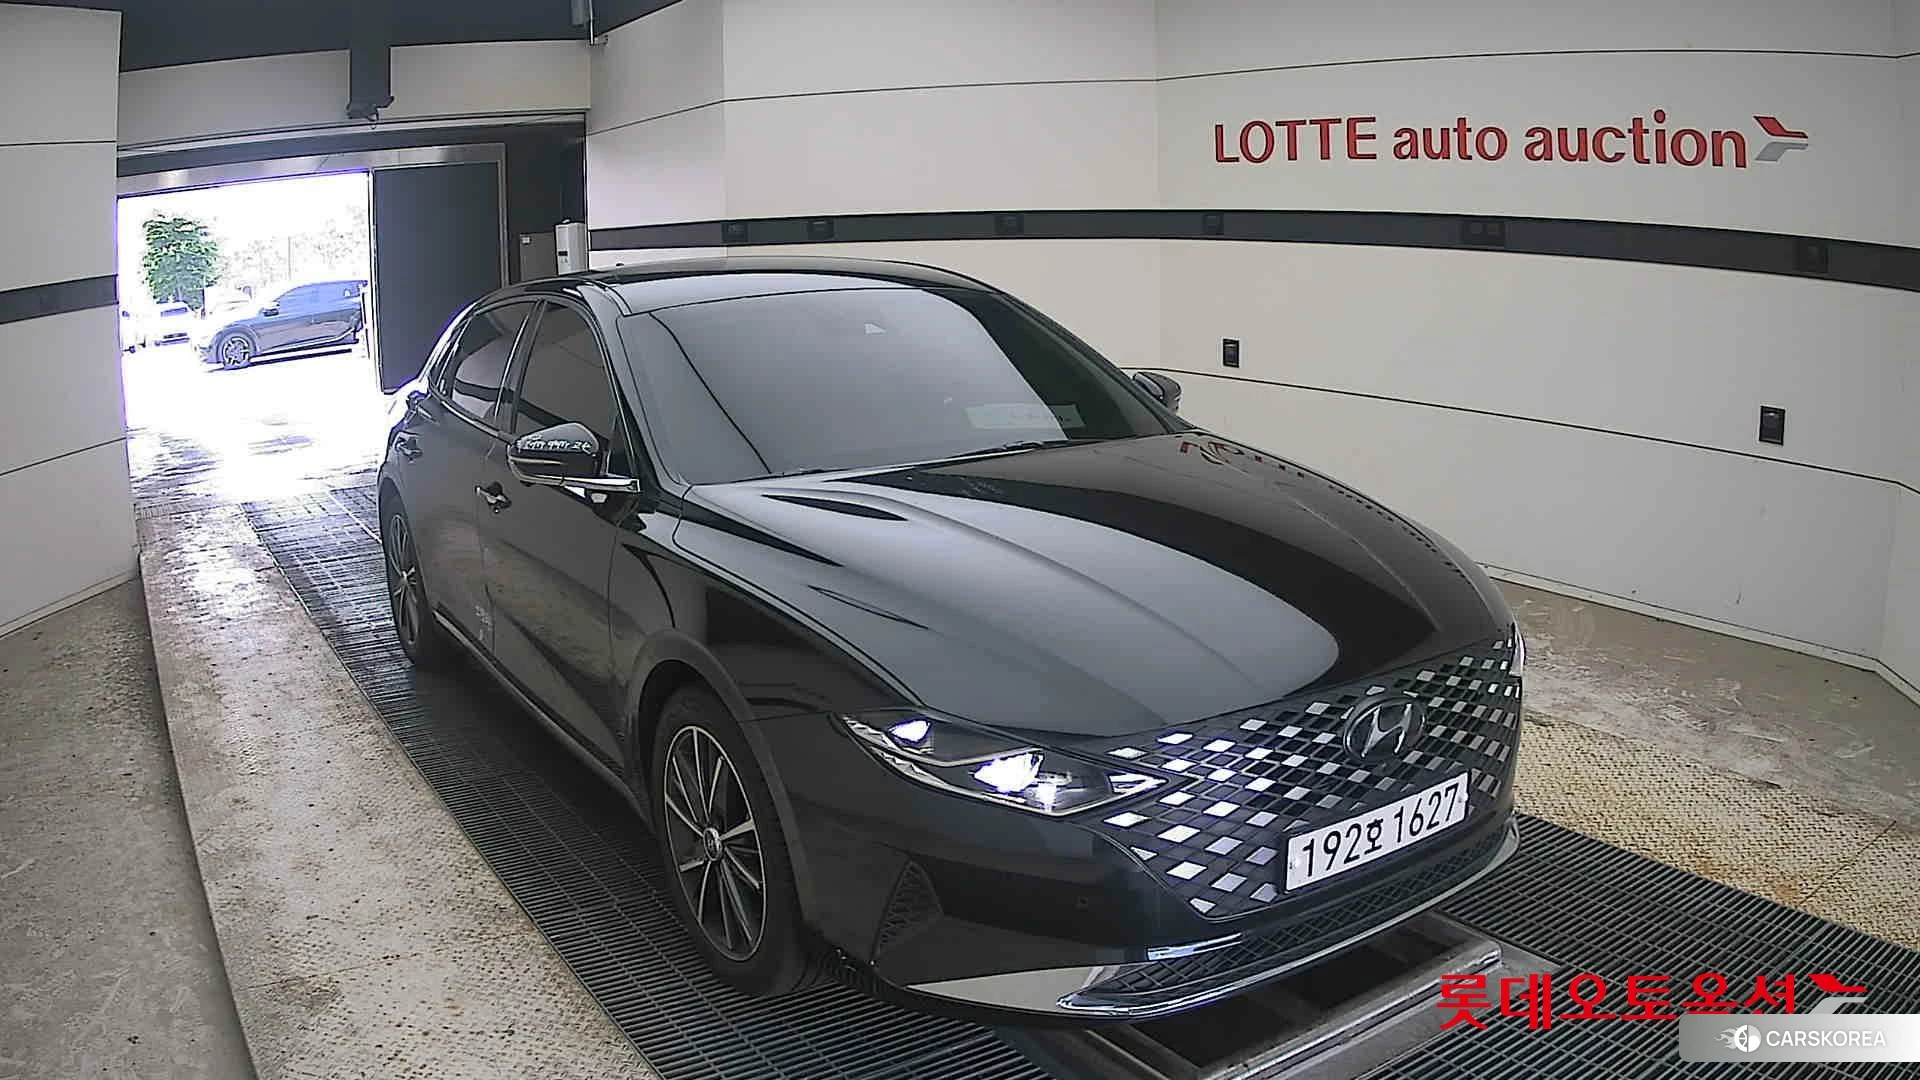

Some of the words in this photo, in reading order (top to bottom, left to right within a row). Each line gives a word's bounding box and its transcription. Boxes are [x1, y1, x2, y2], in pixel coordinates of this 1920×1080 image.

[1214, 116, 1377, 163] LOTTE
[1393, 117, 1509, 160] auto
[1523, 110, 1748, 168] auction
[1302, 818, 1384, 878] 192호
[1393, 782, 1460, 843] 1627
